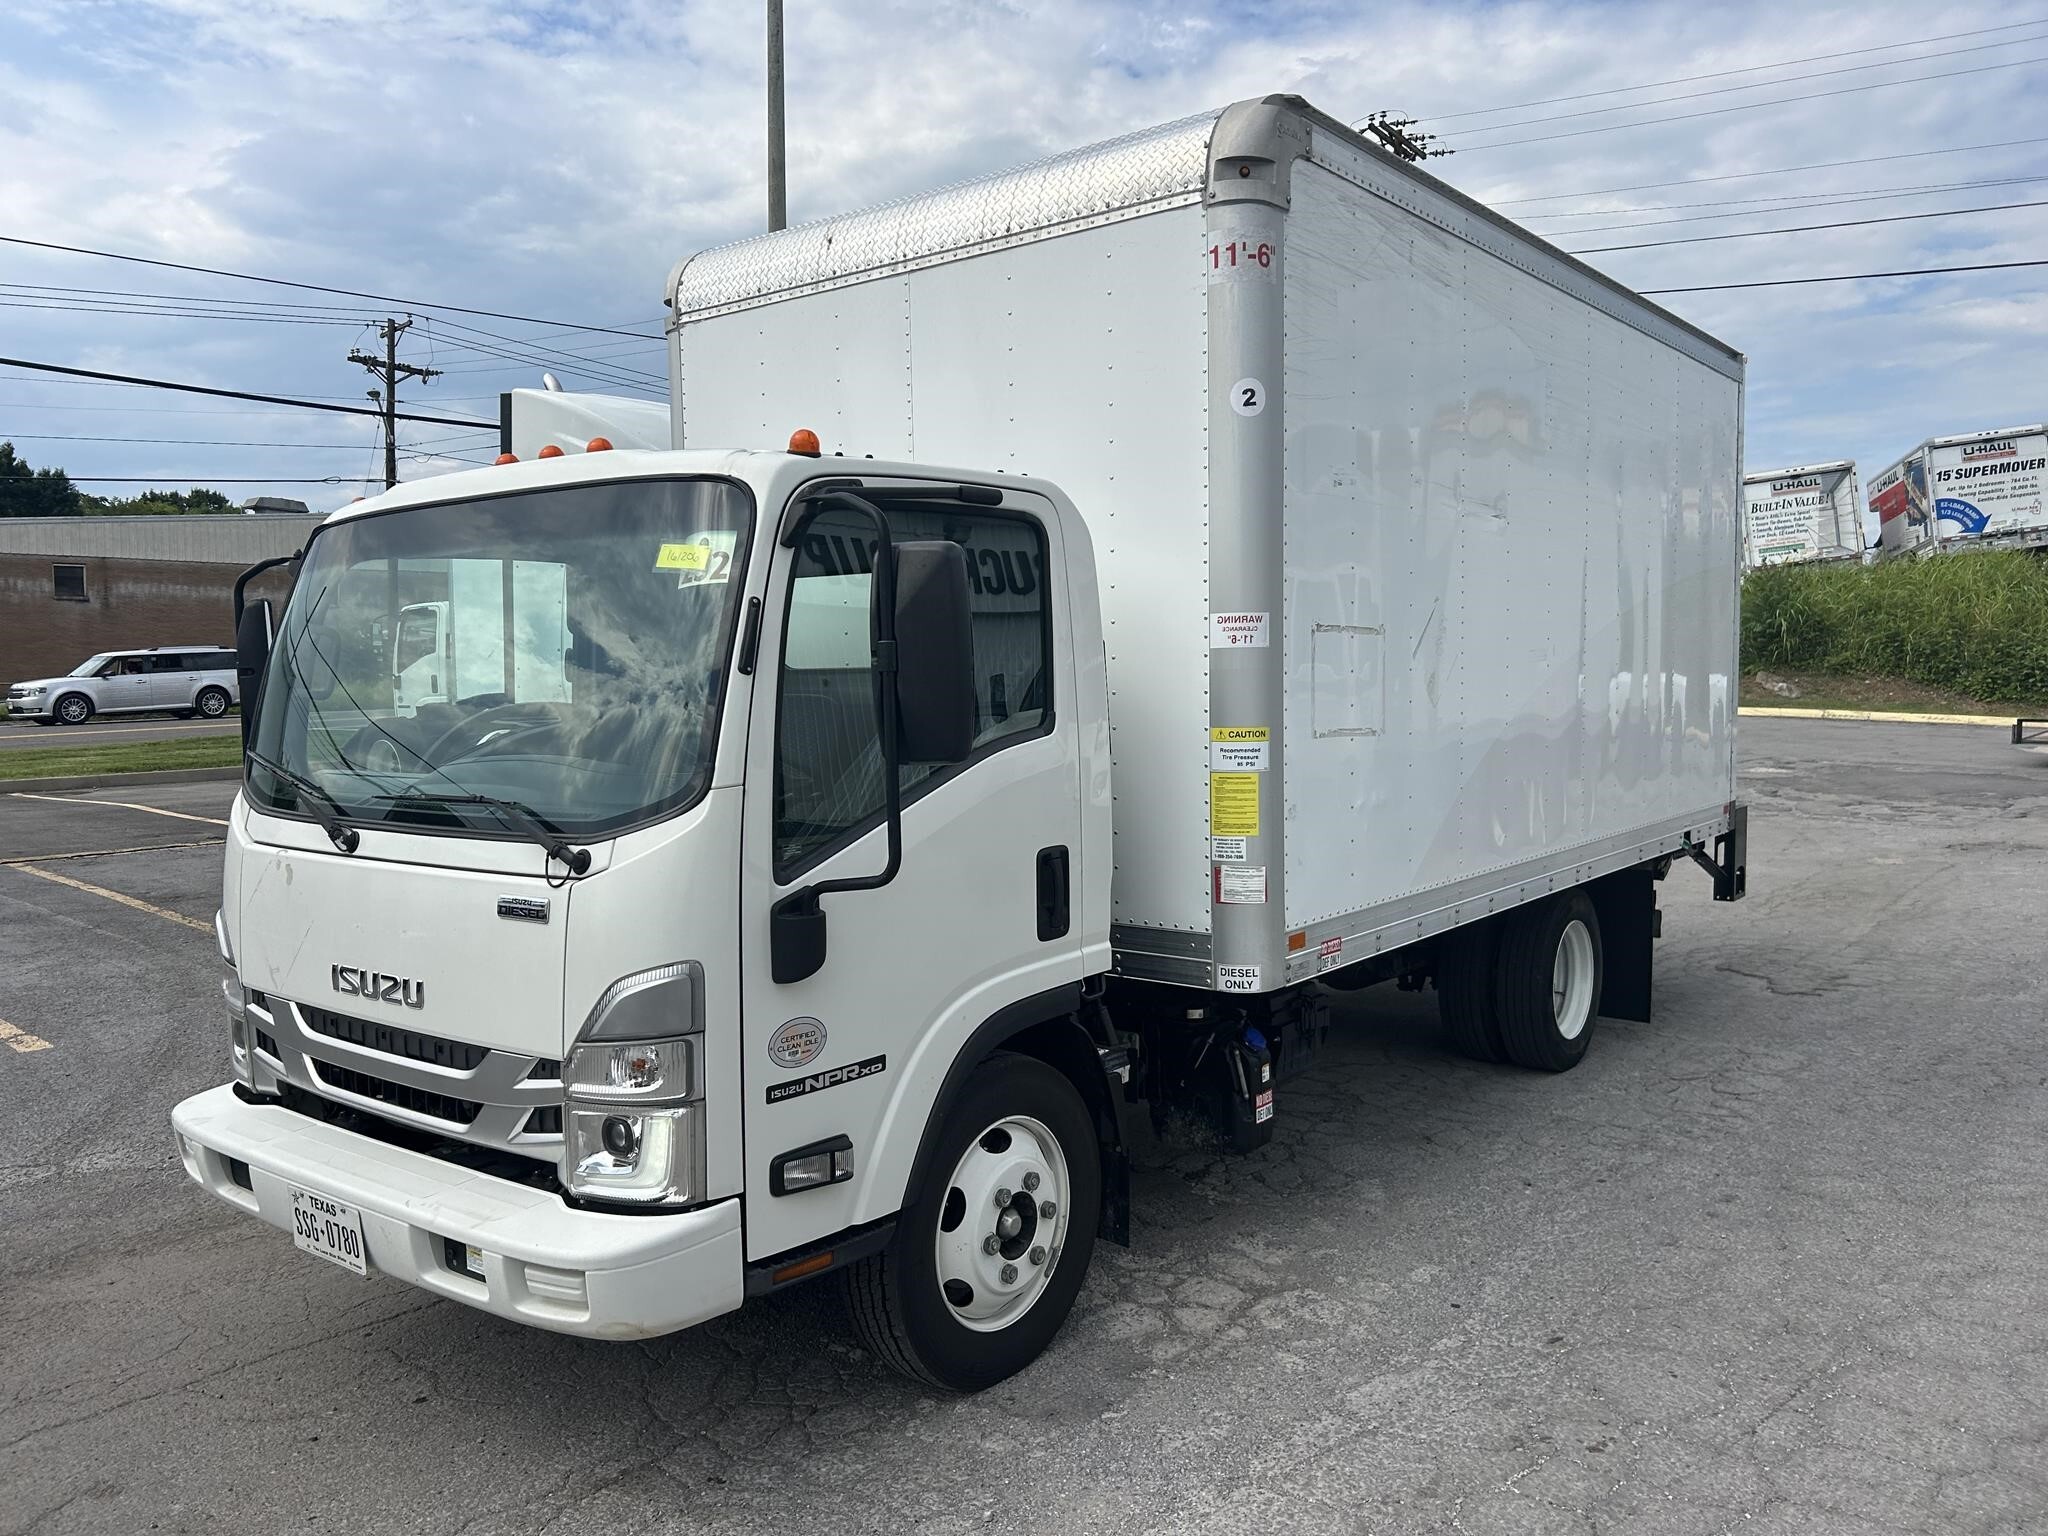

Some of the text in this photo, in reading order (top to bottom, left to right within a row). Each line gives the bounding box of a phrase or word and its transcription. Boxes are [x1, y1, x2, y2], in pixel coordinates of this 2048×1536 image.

[1241, 388, 1257, 407] 2
[1963, 441, 2015, 456] U-HAUL
[1936, 457, 2046, 482] 15' SUPERMOVER
[1772, 478, 1821, 491] U-HAUL
[1876, 470, 1899, 493] U-HAUL
[1228, 730, 1266, 739] CAUTION
[1220, 967, 1258, 978] DIESEL
[331, 962, 425, 1010] ISUZU
[1224, 979, 1254, 990] ONLY
[777, 1041, 802, 1053] CLEAN
[803, 1037, 819, 1047] IDLE
[780, 1030, 816, 1044] CERTIFIED
[771, 1083, 803, 1099] ISUZU
[308, 1195, 337, 1217] TEXAS
